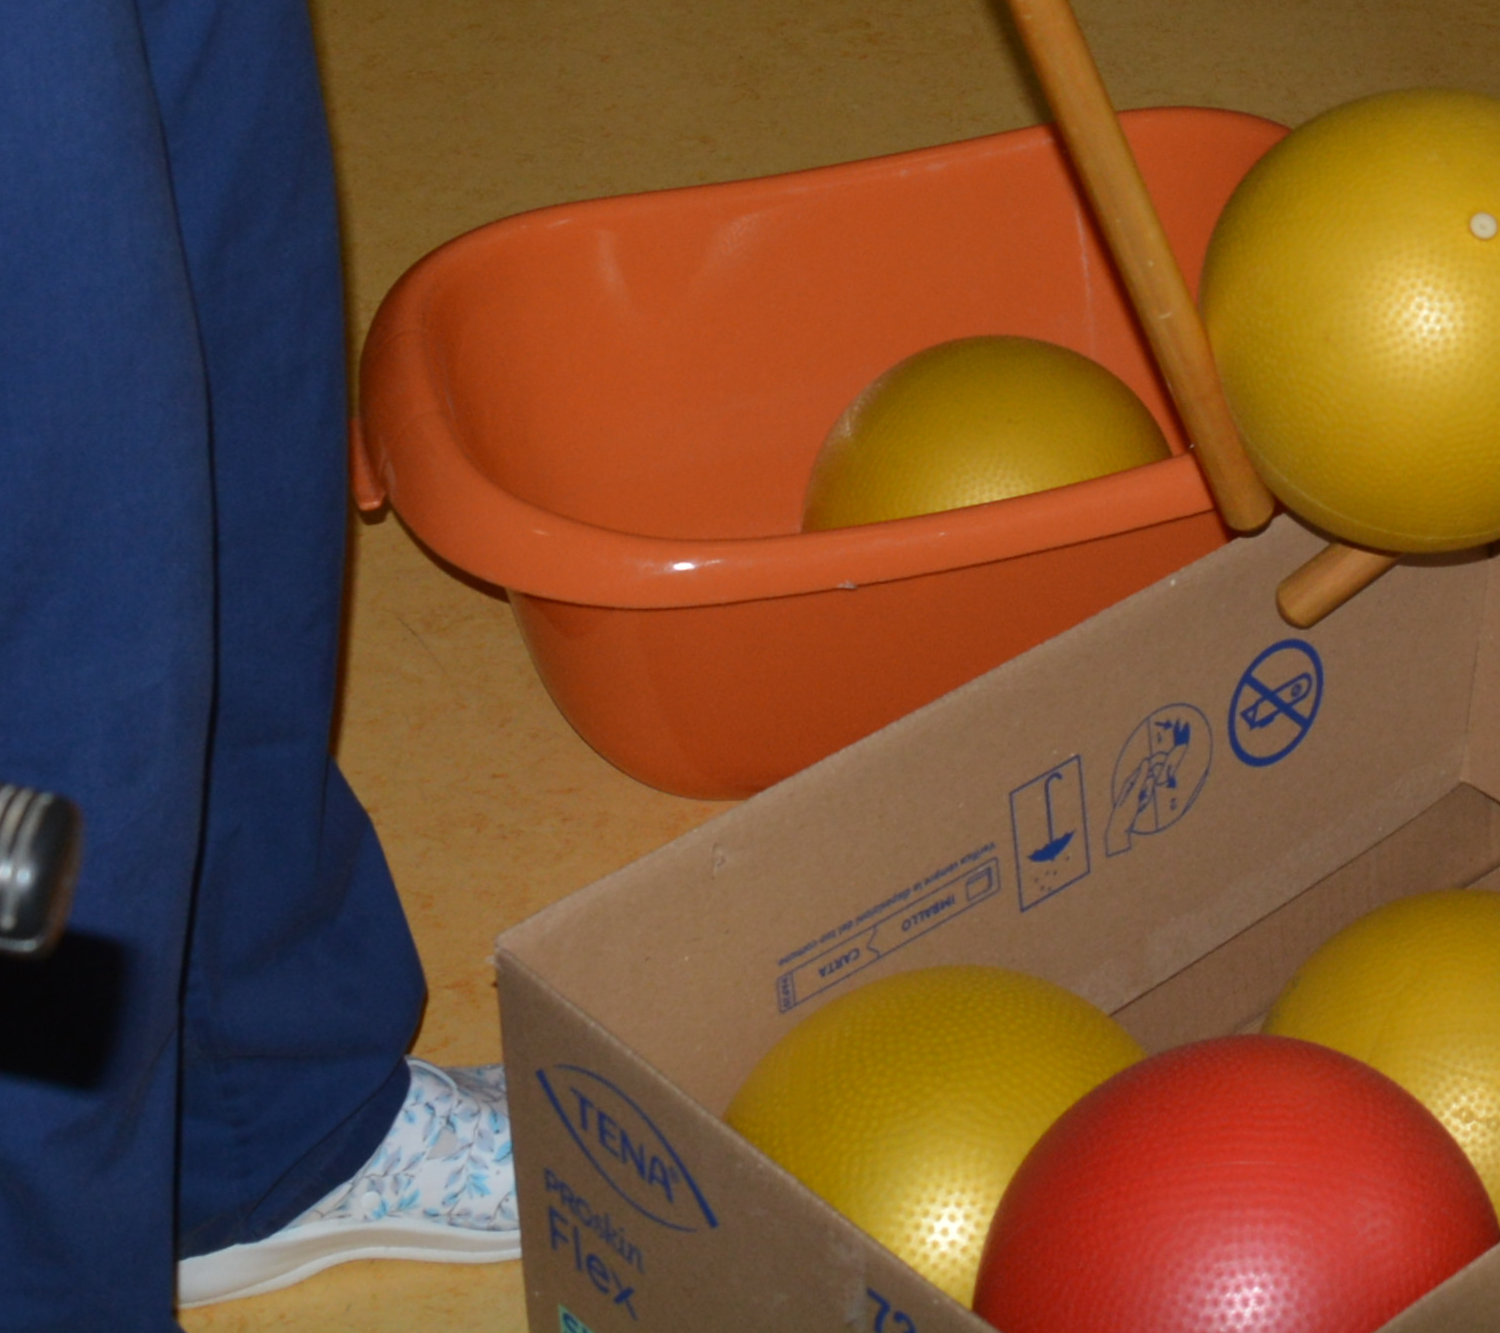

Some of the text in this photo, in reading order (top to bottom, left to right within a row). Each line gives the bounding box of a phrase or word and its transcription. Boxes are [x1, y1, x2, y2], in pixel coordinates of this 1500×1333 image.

[901, 894, 957, 933] IMBALLO
[817, 947, 862, 979] CARTA
[547, 1207, 639, 1321] Flex
